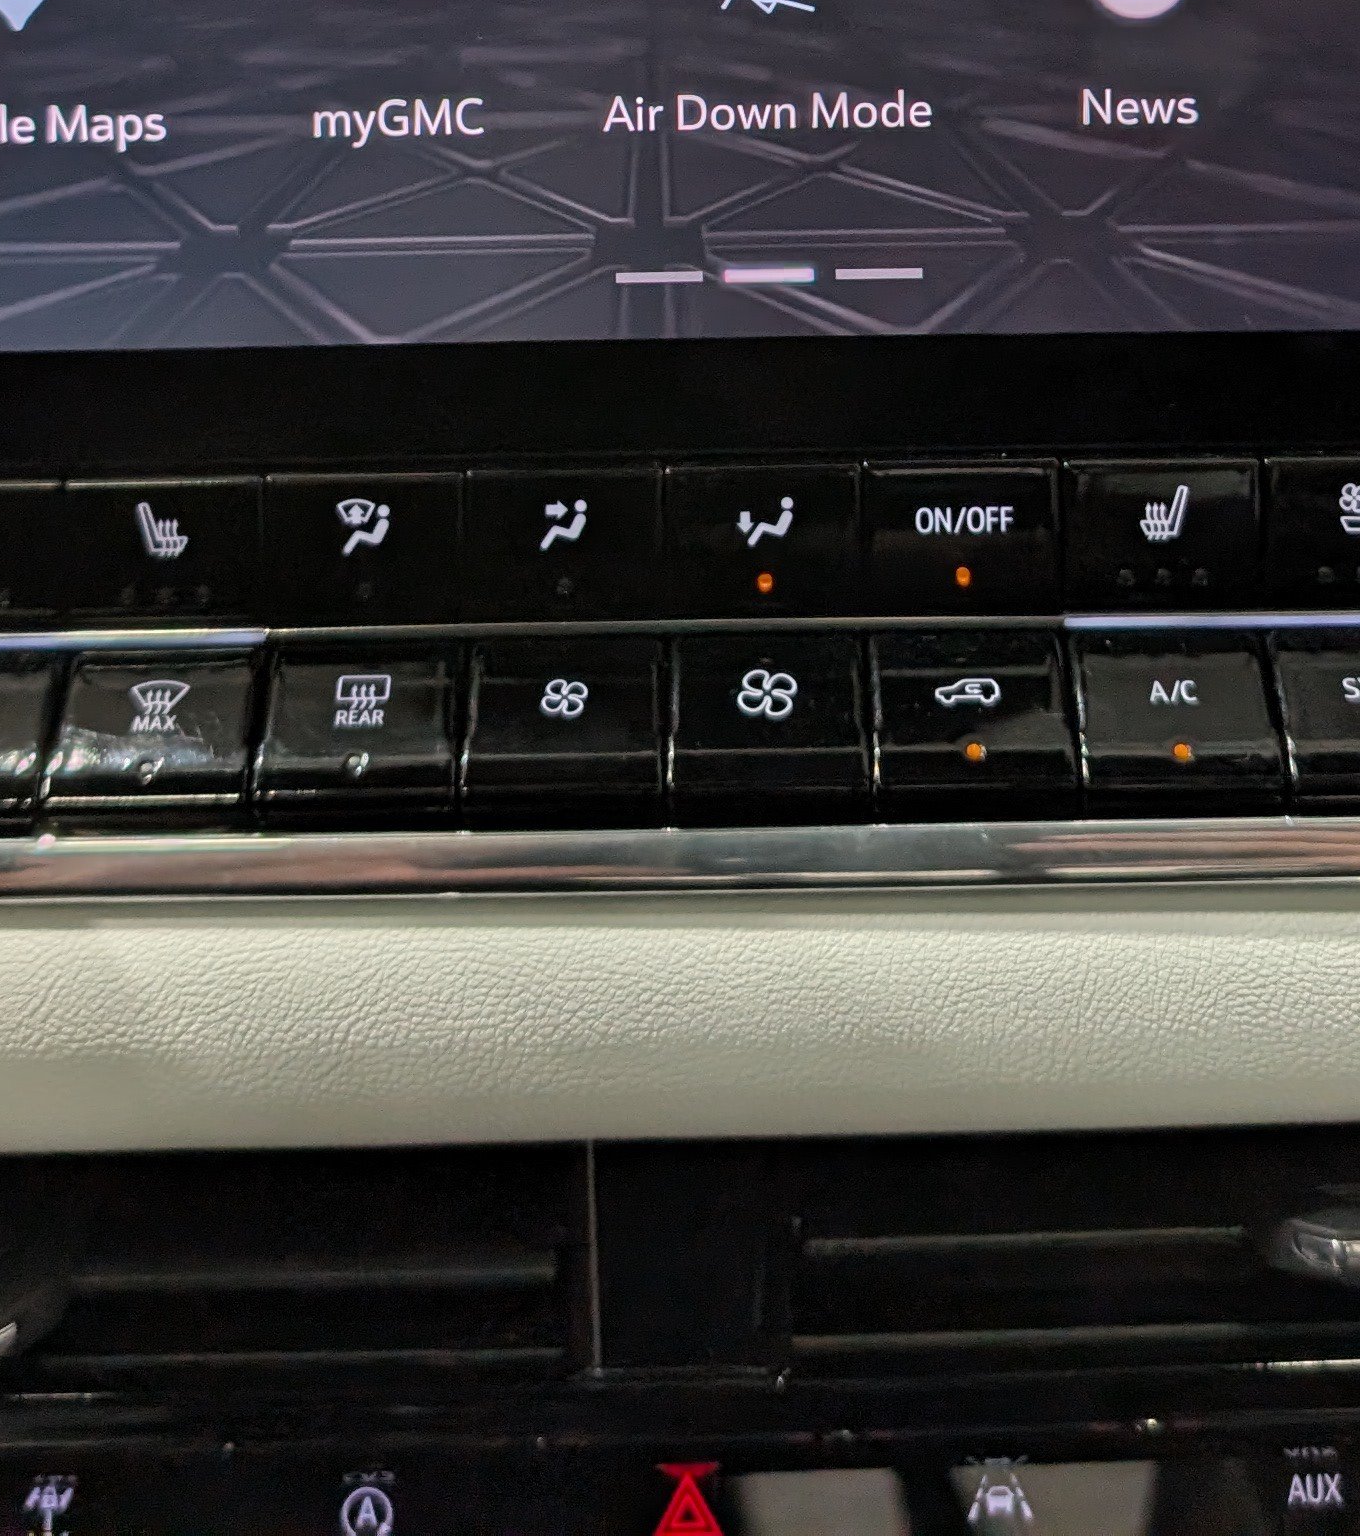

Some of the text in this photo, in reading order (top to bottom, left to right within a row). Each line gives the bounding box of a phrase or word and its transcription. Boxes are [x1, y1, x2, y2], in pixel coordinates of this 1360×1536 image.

[603, 90, 932, 132] Air Down Mode
[1083, 89, 1198, 125] News
[47, 105, 167, 152] Maps
[313, 98, 484, 148] myGMC
[916, 506, 1013, 534] ON/OFF
[1150, 680, 1197, 703] A/C
[132, 712, 175, 732] MAX
[335, 706, 384, 726] REAR
[1288, 1474, 1342, 1505] AUX
